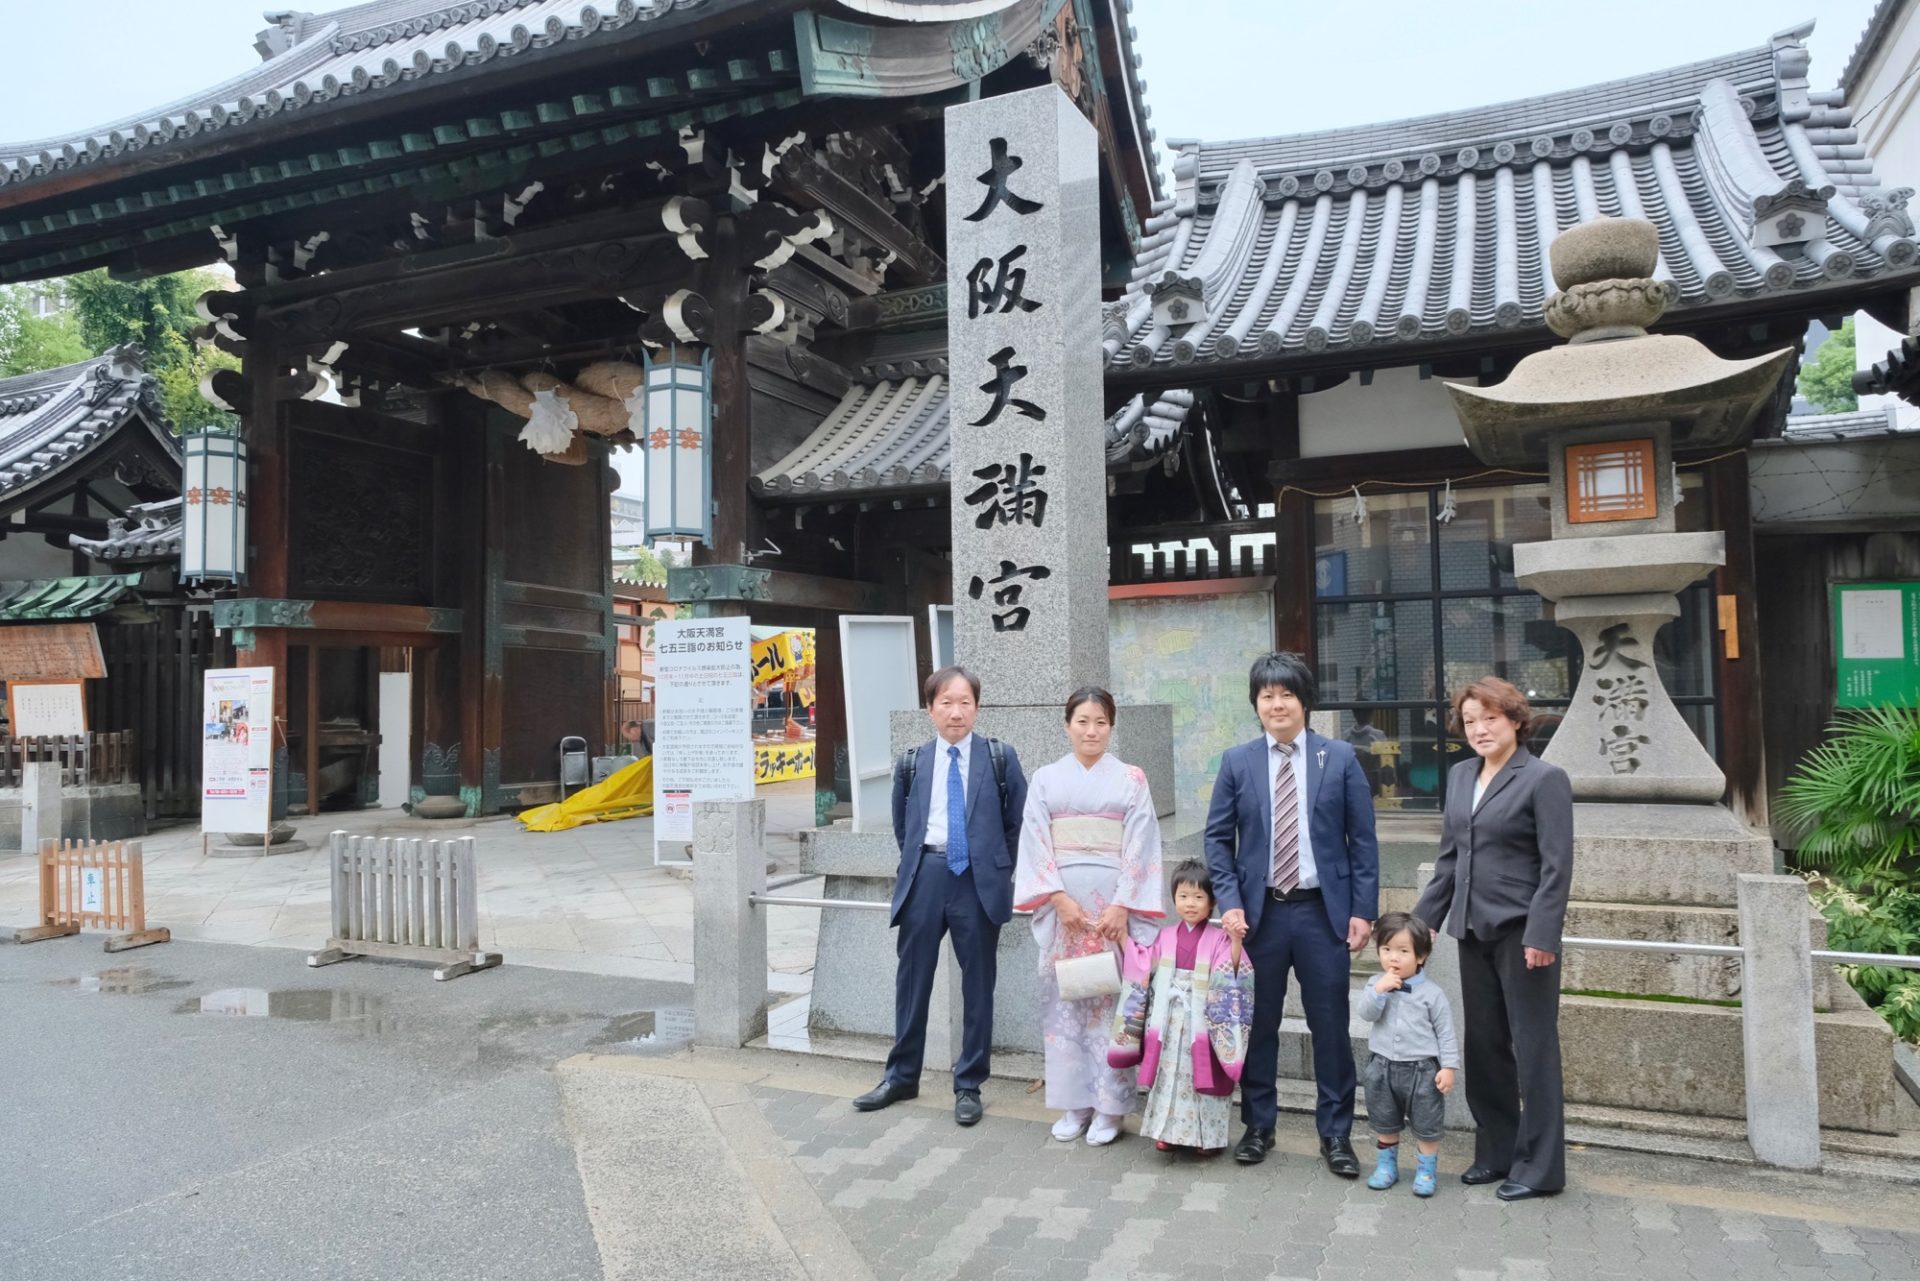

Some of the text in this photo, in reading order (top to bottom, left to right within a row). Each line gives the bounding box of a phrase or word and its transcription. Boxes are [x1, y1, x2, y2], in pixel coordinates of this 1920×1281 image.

[677, 627, 725, 639] 大阪天満宮
[659, 640, 743, 654] 七五三詣のお知らせ
